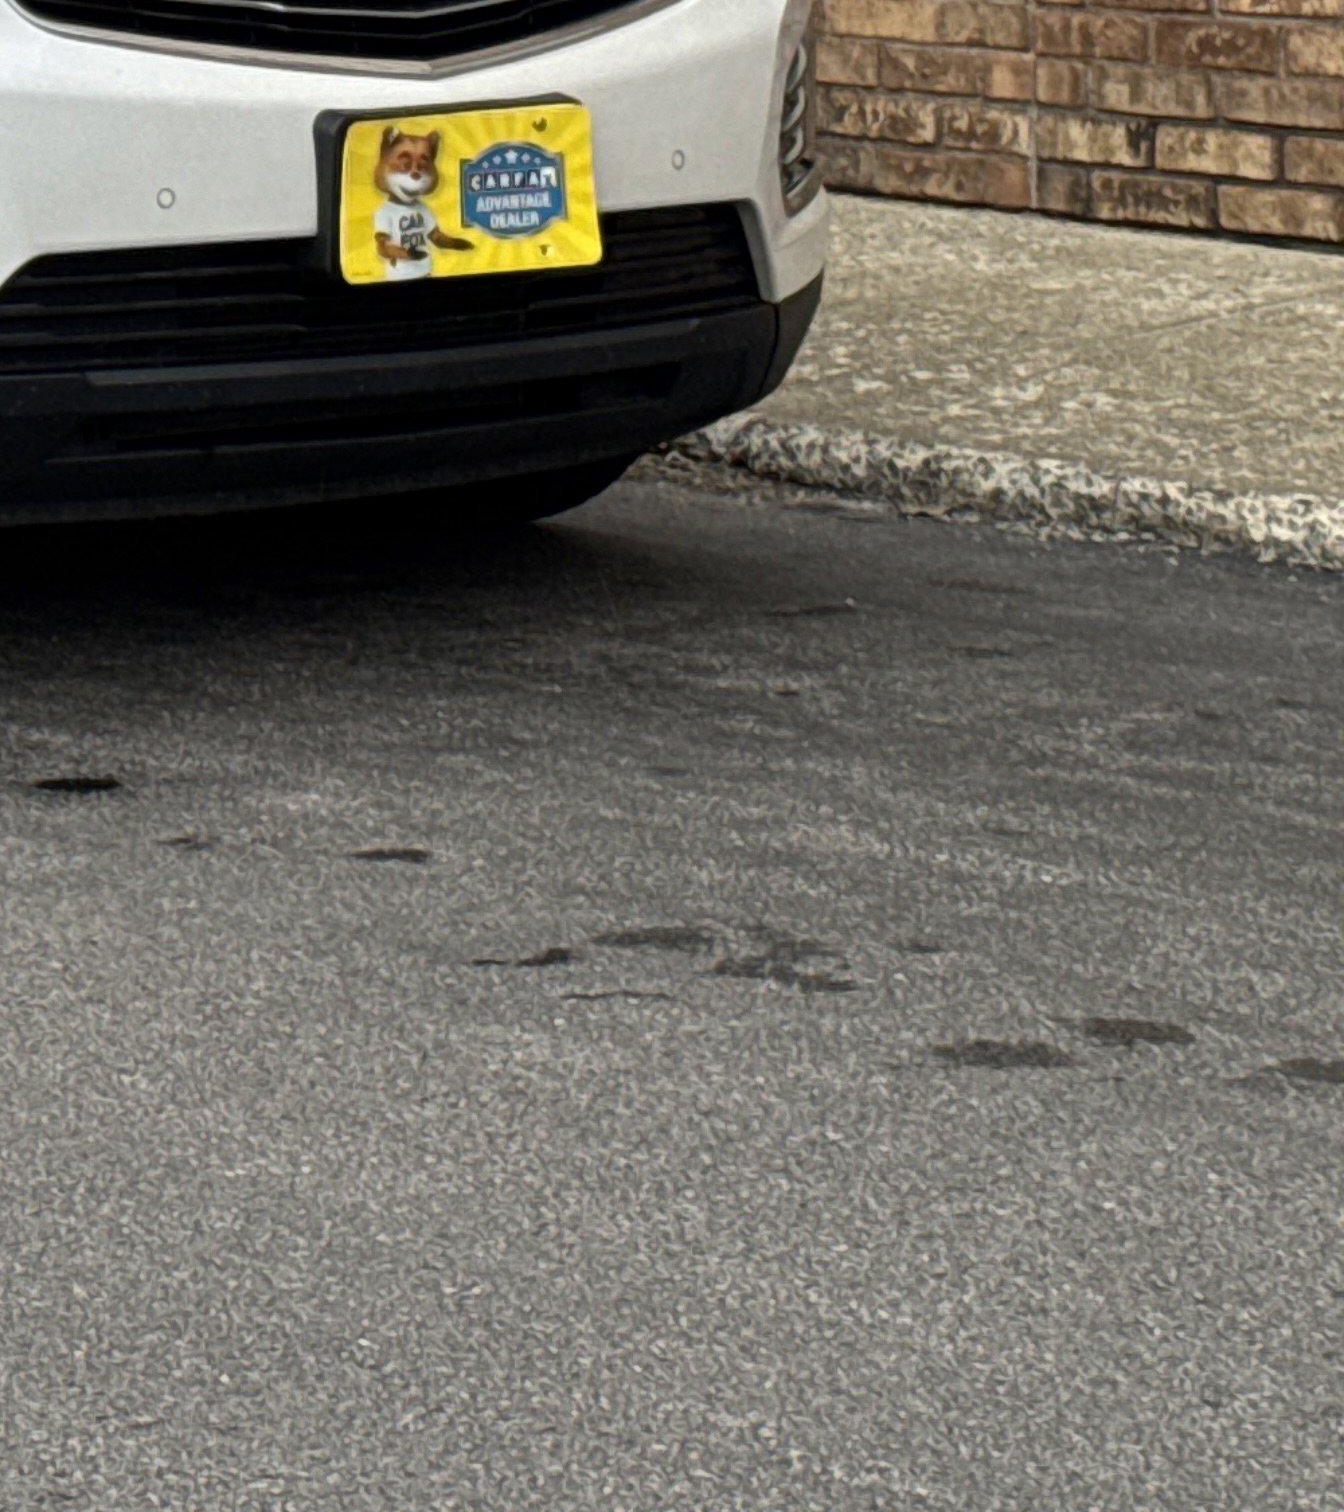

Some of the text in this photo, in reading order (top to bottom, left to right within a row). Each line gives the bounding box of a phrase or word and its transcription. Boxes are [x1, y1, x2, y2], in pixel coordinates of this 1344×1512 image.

[470, 166, 558, 191] CARFAX
[475, 191, 552, 213] ADVANTAGE
[489, 210, 540, 229] DEALER
